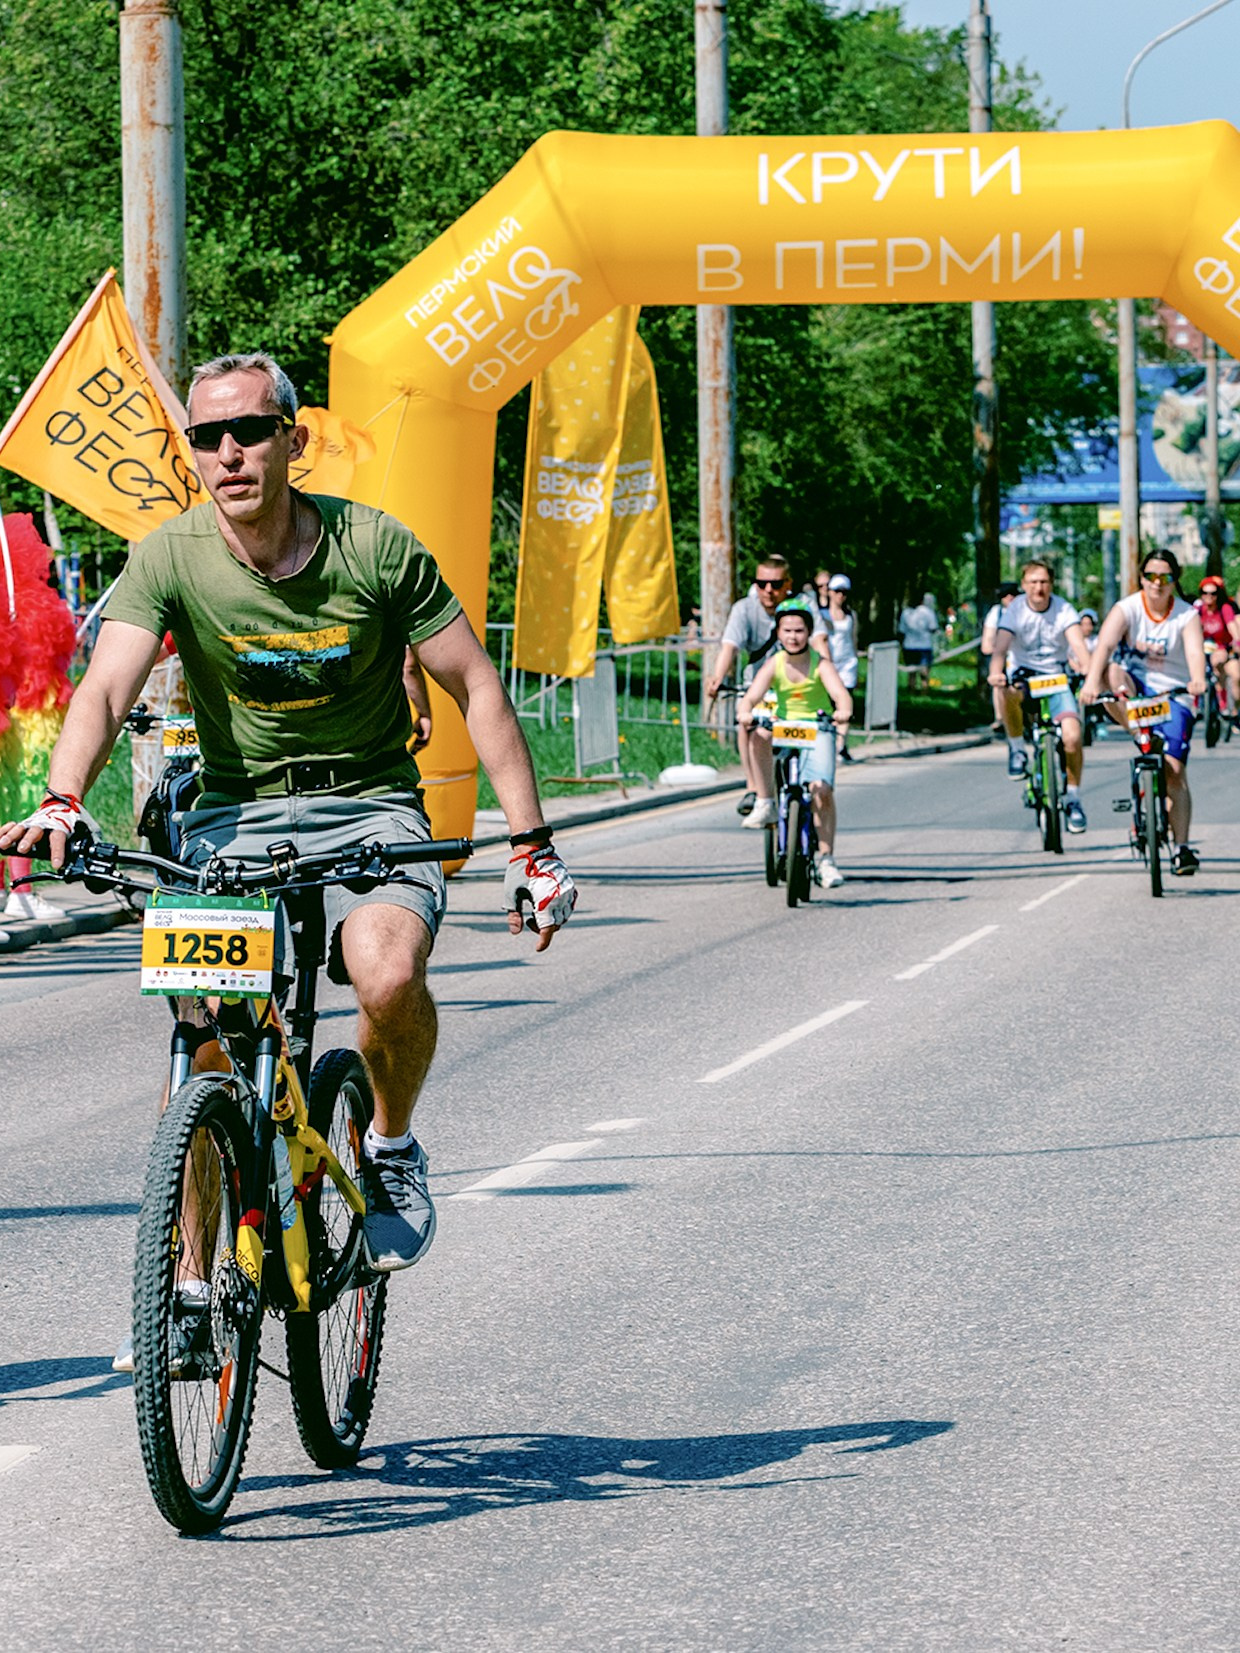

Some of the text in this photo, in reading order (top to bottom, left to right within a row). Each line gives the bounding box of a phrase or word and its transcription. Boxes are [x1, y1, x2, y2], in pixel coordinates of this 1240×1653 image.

[758, 145, 1022, 205] КРУТИ
[404, 215, 523, 329] ПЕРМСКИЙ
[697, 227, 1084, 292] В ПЕРМИ!
[784, 727, 806, 739] 905
[163, 932, 249, 967] 1258
